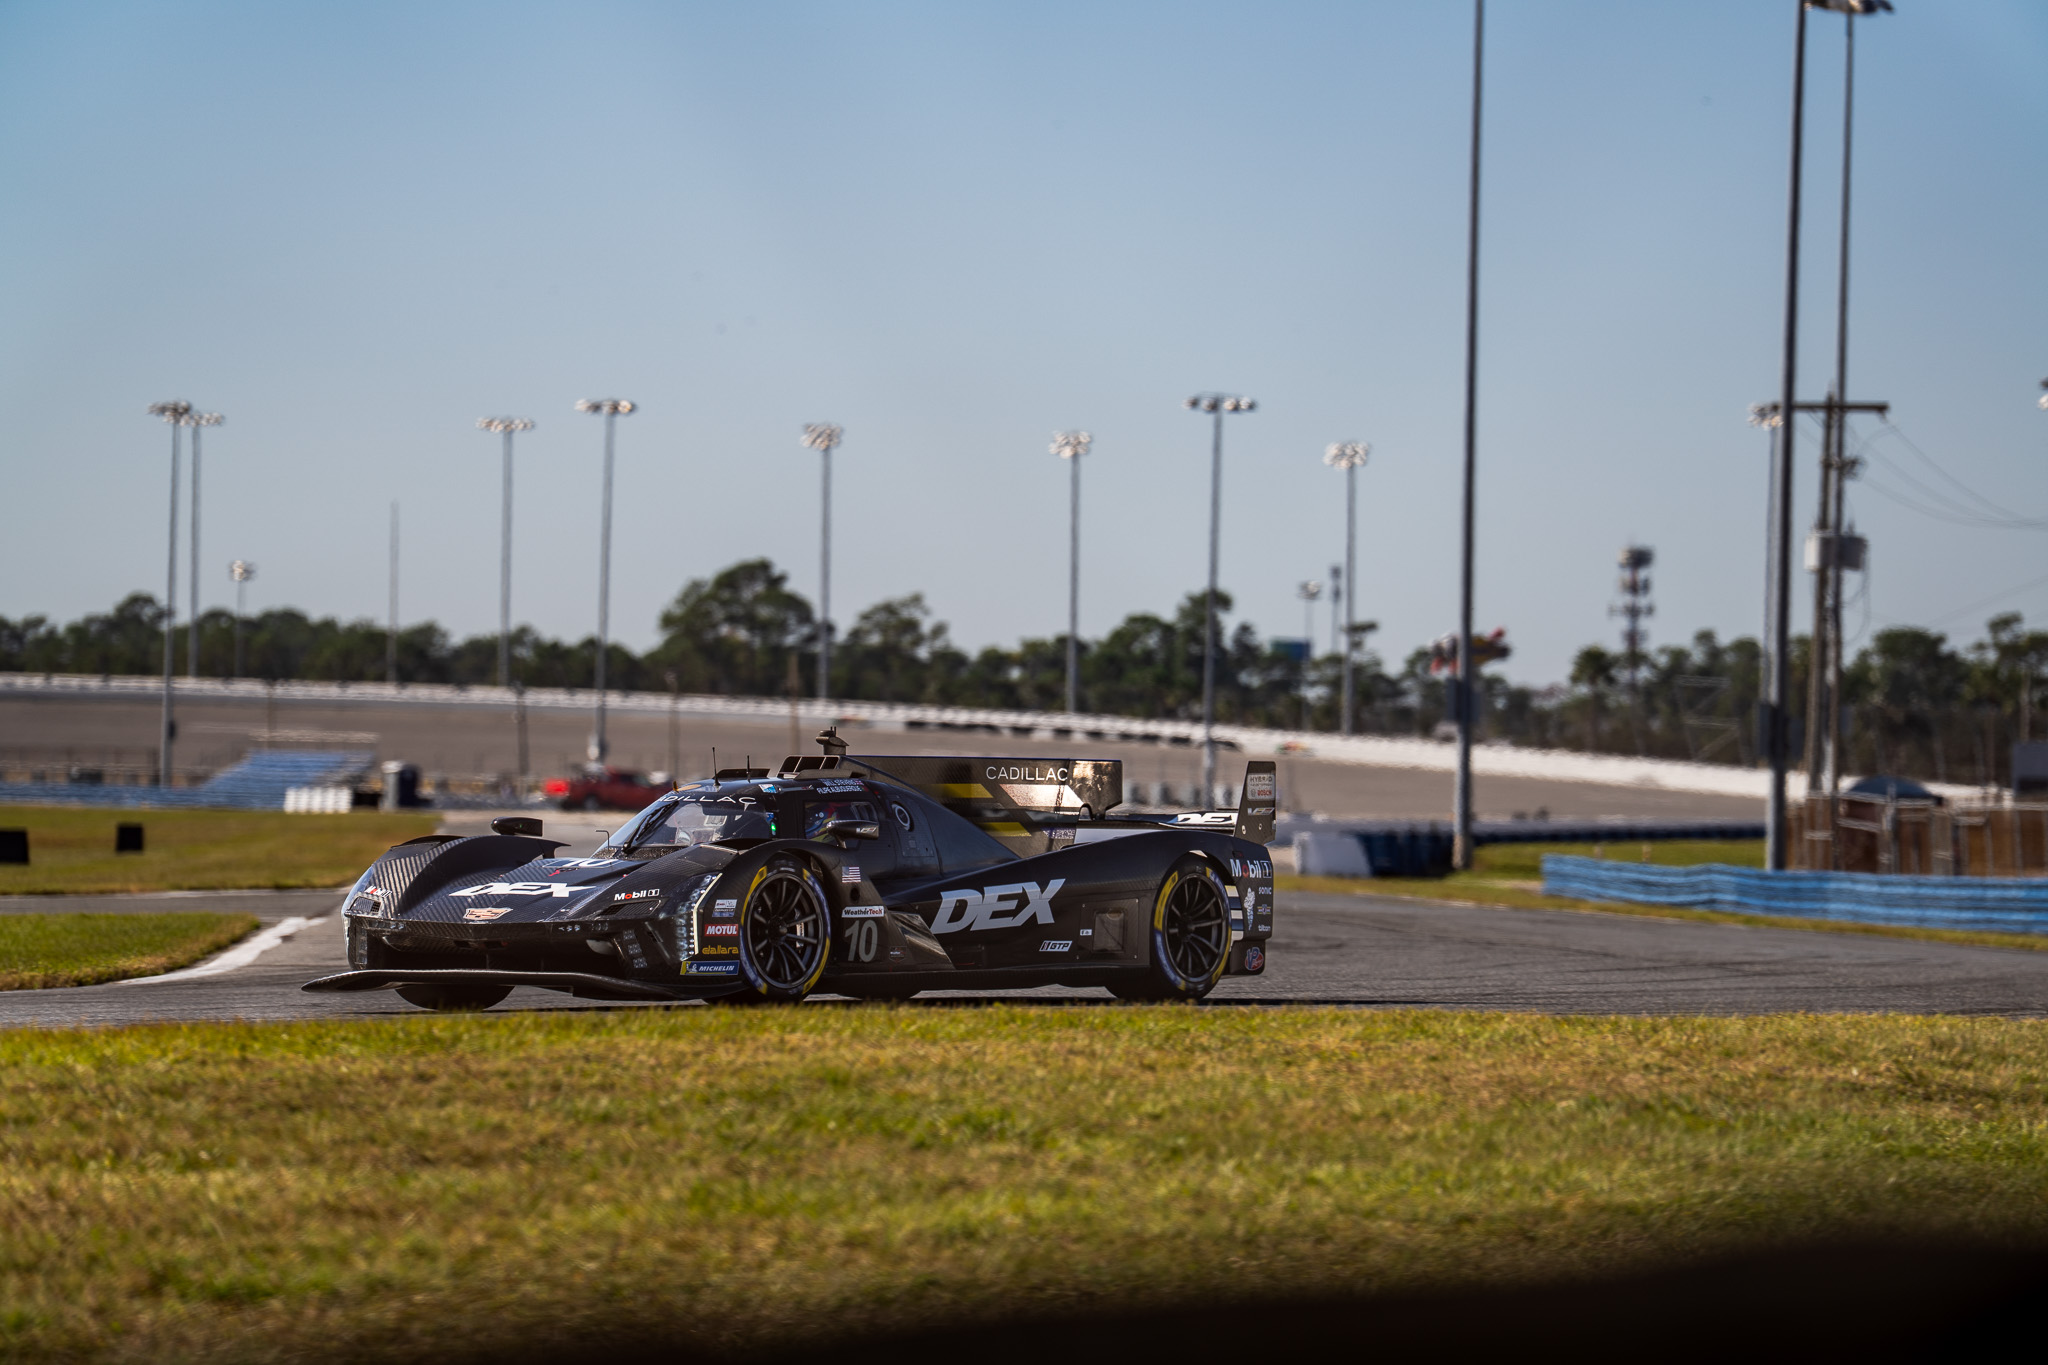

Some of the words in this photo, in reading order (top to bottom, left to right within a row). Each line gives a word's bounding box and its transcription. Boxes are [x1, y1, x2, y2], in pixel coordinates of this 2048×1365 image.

[986, 767, 1068, 781] CADILLAC
[1230, 859, 1262, 878] Mobil
[1263, 861, 1271, 877] 1
[449, 882, 596, 898] DEX
[614, 890, 646, 900] Mobil
[843, 908, 883, 916] WeatherTech
[930, 878, 1066, 934] DEX
[706, 925, 737, 935] MOTUL
[844, 920, 878, 962] 10
[1050, 942, 1070, 950] GTP
[702, 945, 739, 954] dallara
